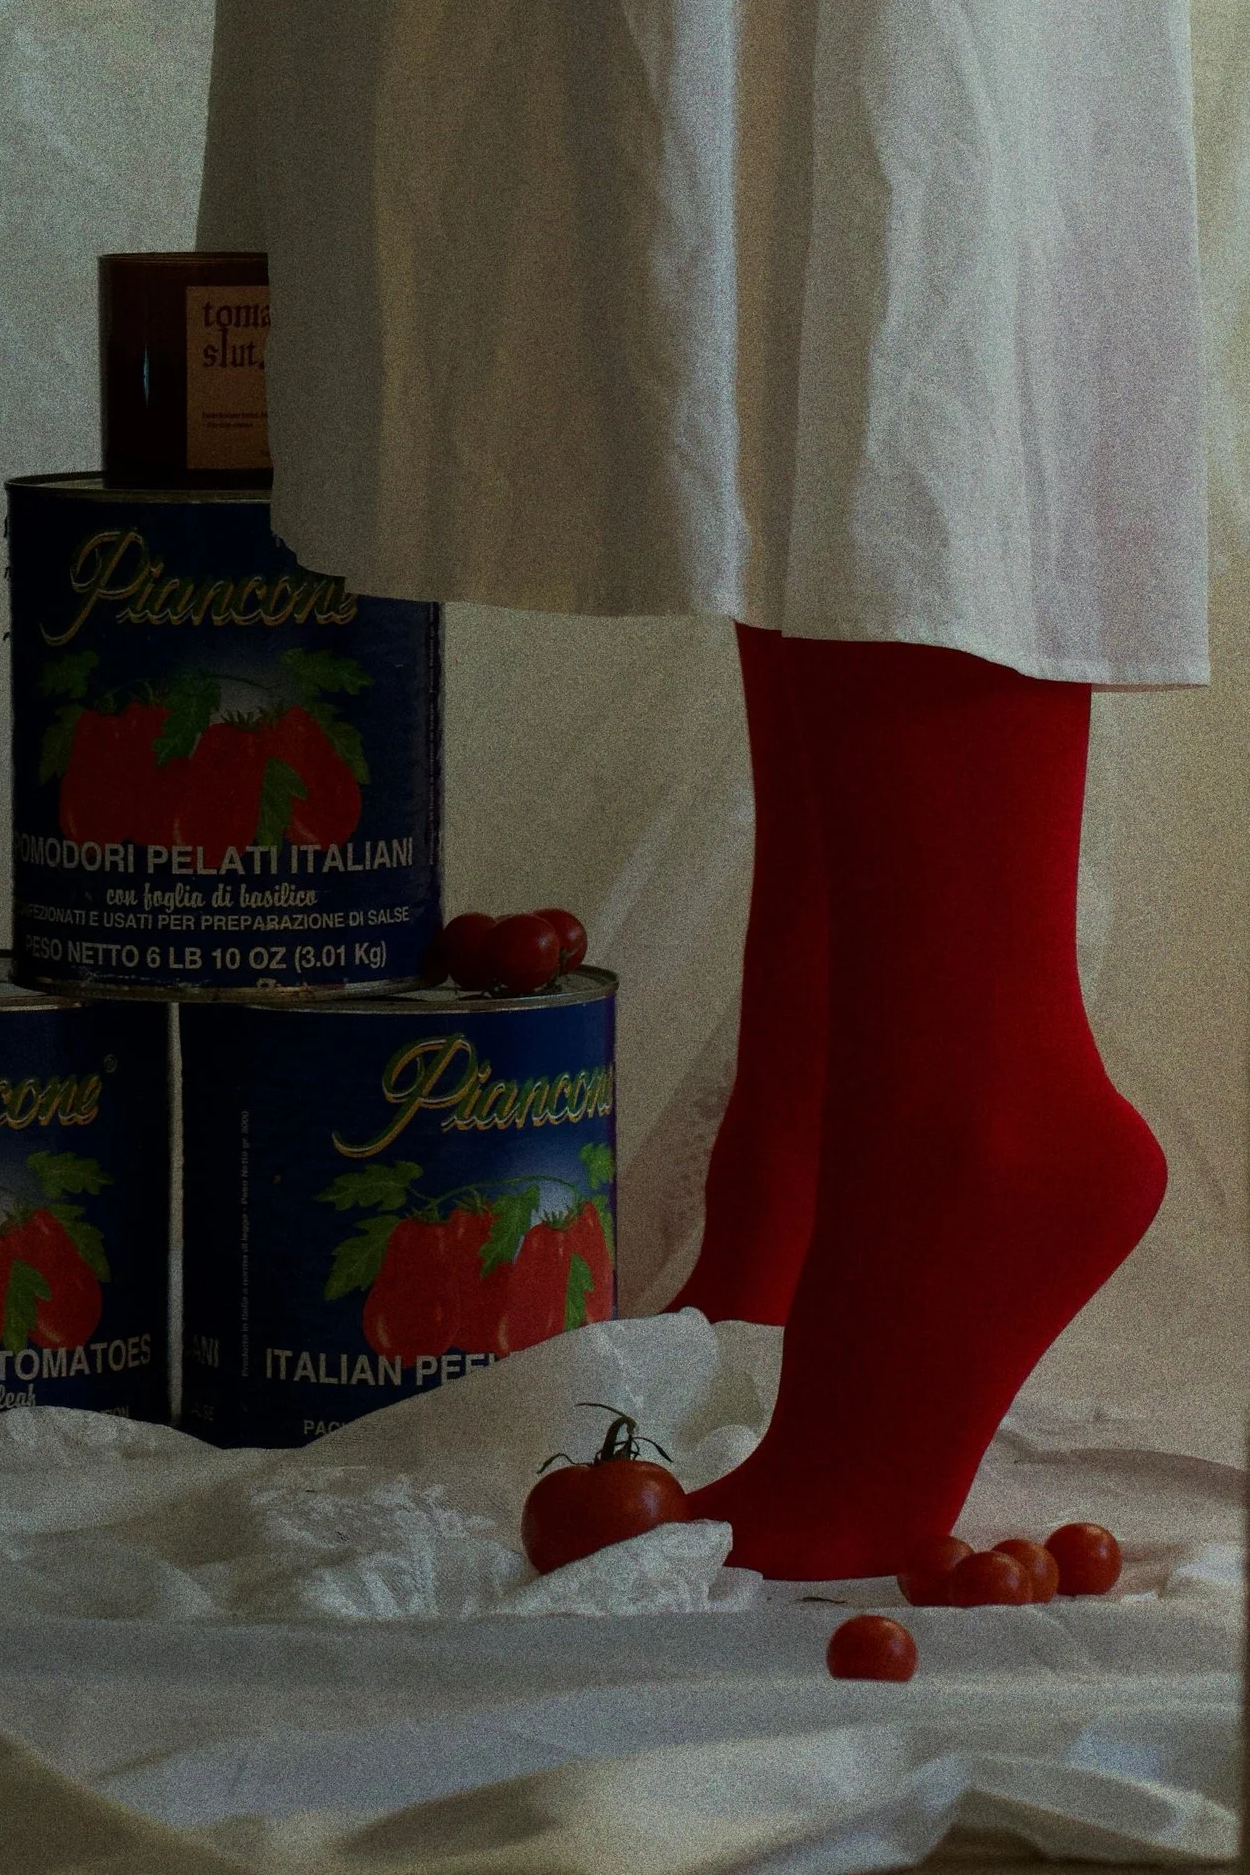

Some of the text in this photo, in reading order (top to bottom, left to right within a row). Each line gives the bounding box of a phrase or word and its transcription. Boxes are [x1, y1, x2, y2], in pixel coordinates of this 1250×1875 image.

[202, 301, 271, 328] toma
[147, 843, 278, 875] PELATI
[291, 836, 414, 875] ITALIANI
[106, 882, 318, 913] con foglia di basilico
[89, 911, 100, 926] E
[103, 912, 152, 930] USATI
[158, 914, 195, 931] PER
[201, 912, 346, 932] PREPARAZIONE
[349, 910, 365, 927] DI
[368, 905, 411, 925] SALSE
[25, 933, 388, 973] PESO NETTO 6 LB 10 OZ (3.01 Kg)
[265, 1347, 403, 1387] ITALIAN
